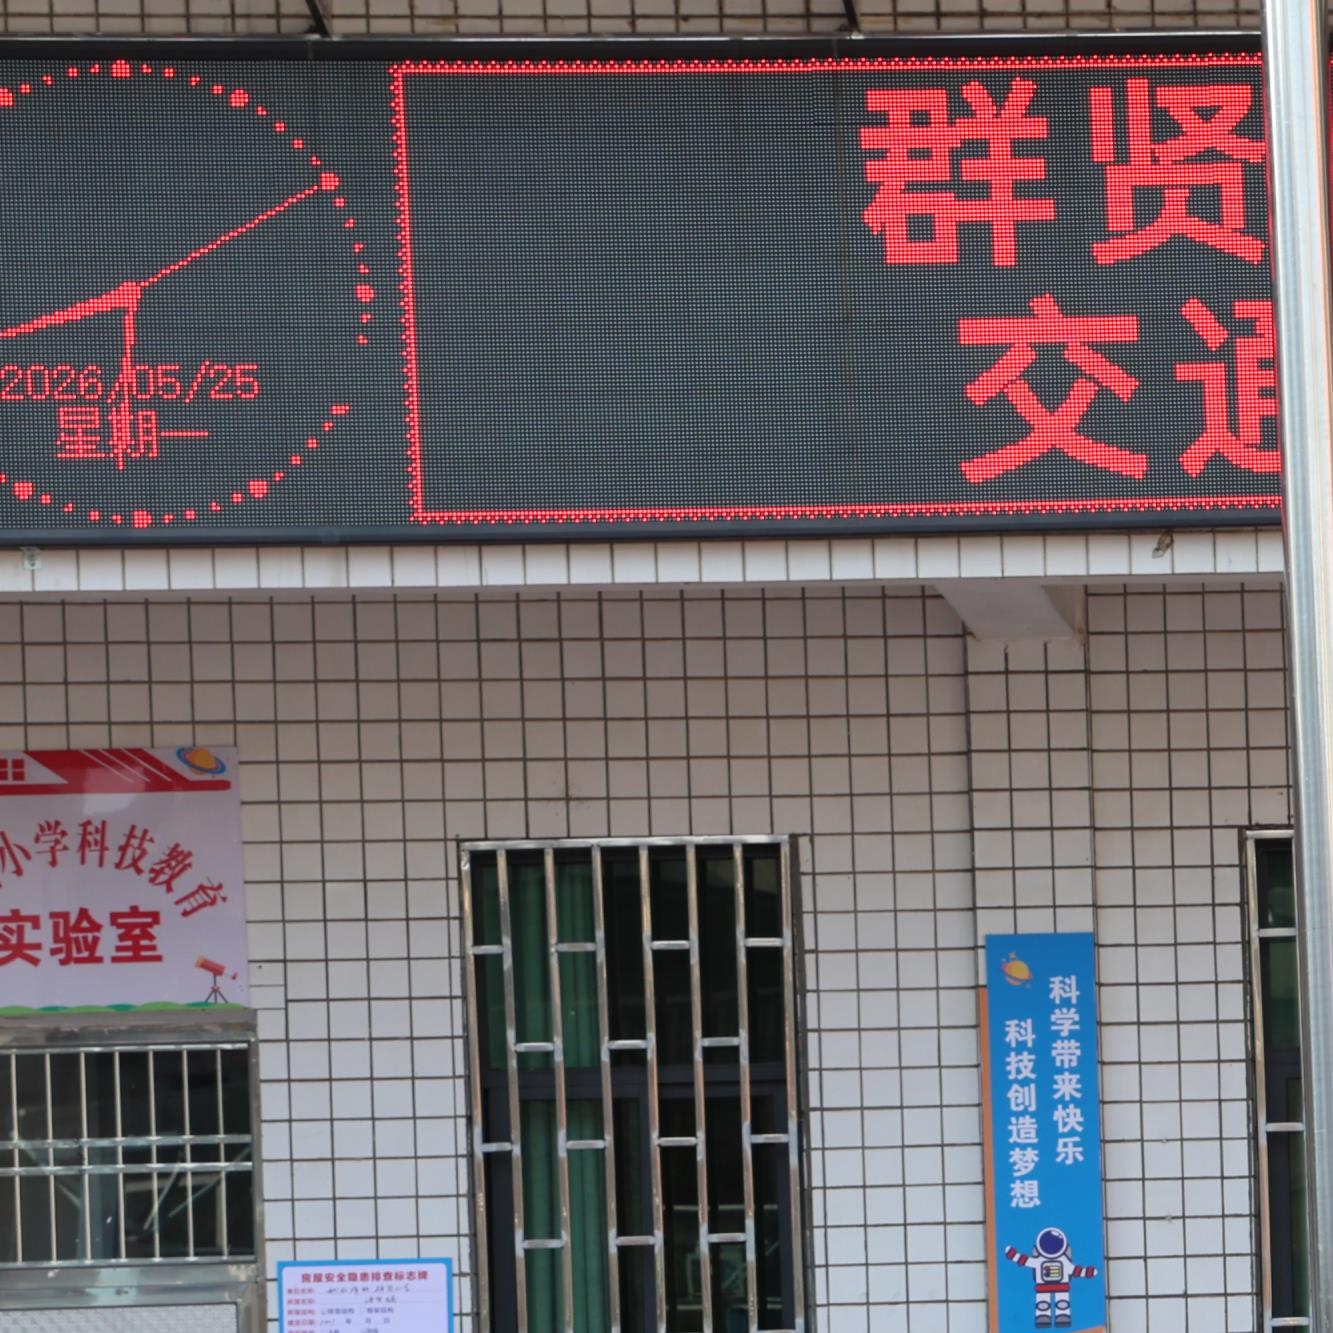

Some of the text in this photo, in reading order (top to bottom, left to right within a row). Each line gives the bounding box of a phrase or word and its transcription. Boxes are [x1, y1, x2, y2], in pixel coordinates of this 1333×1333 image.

[0, 361, 260, 404] 2026/05/25
[55, 406, 210, 459] 星期一
[0, 904, 164, 968] 实验室
[1048, 974, 1086, 1166] 科学带来快乐
[1004, 1017, 1042, 1209] 科技创造梦想
